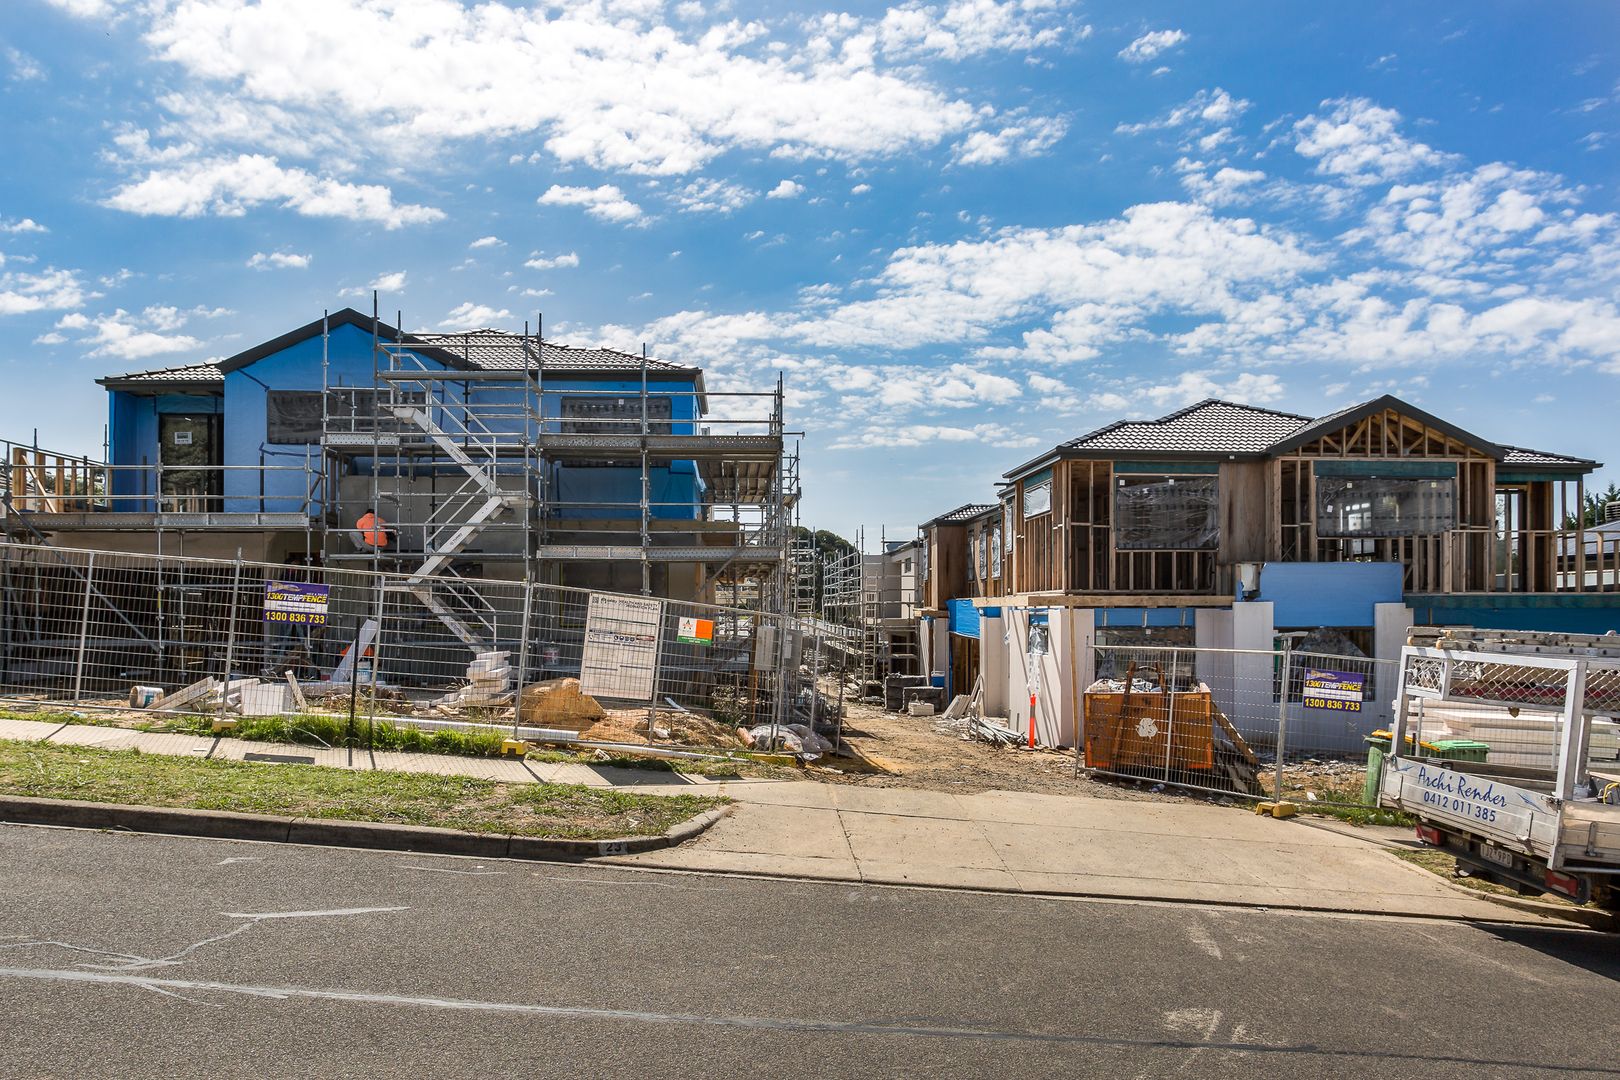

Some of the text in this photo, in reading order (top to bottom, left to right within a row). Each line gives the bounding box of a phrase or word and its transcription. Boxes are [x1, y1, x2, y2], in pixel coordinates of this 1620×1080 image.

[265, 611, 325, 624] 1300 836 733
[1305, 698, 1360, 711] 1300 836 733
[1418, 766, 1507, 808] Archi Render
[1424, 791, 1497, 822] 0412 011 385
